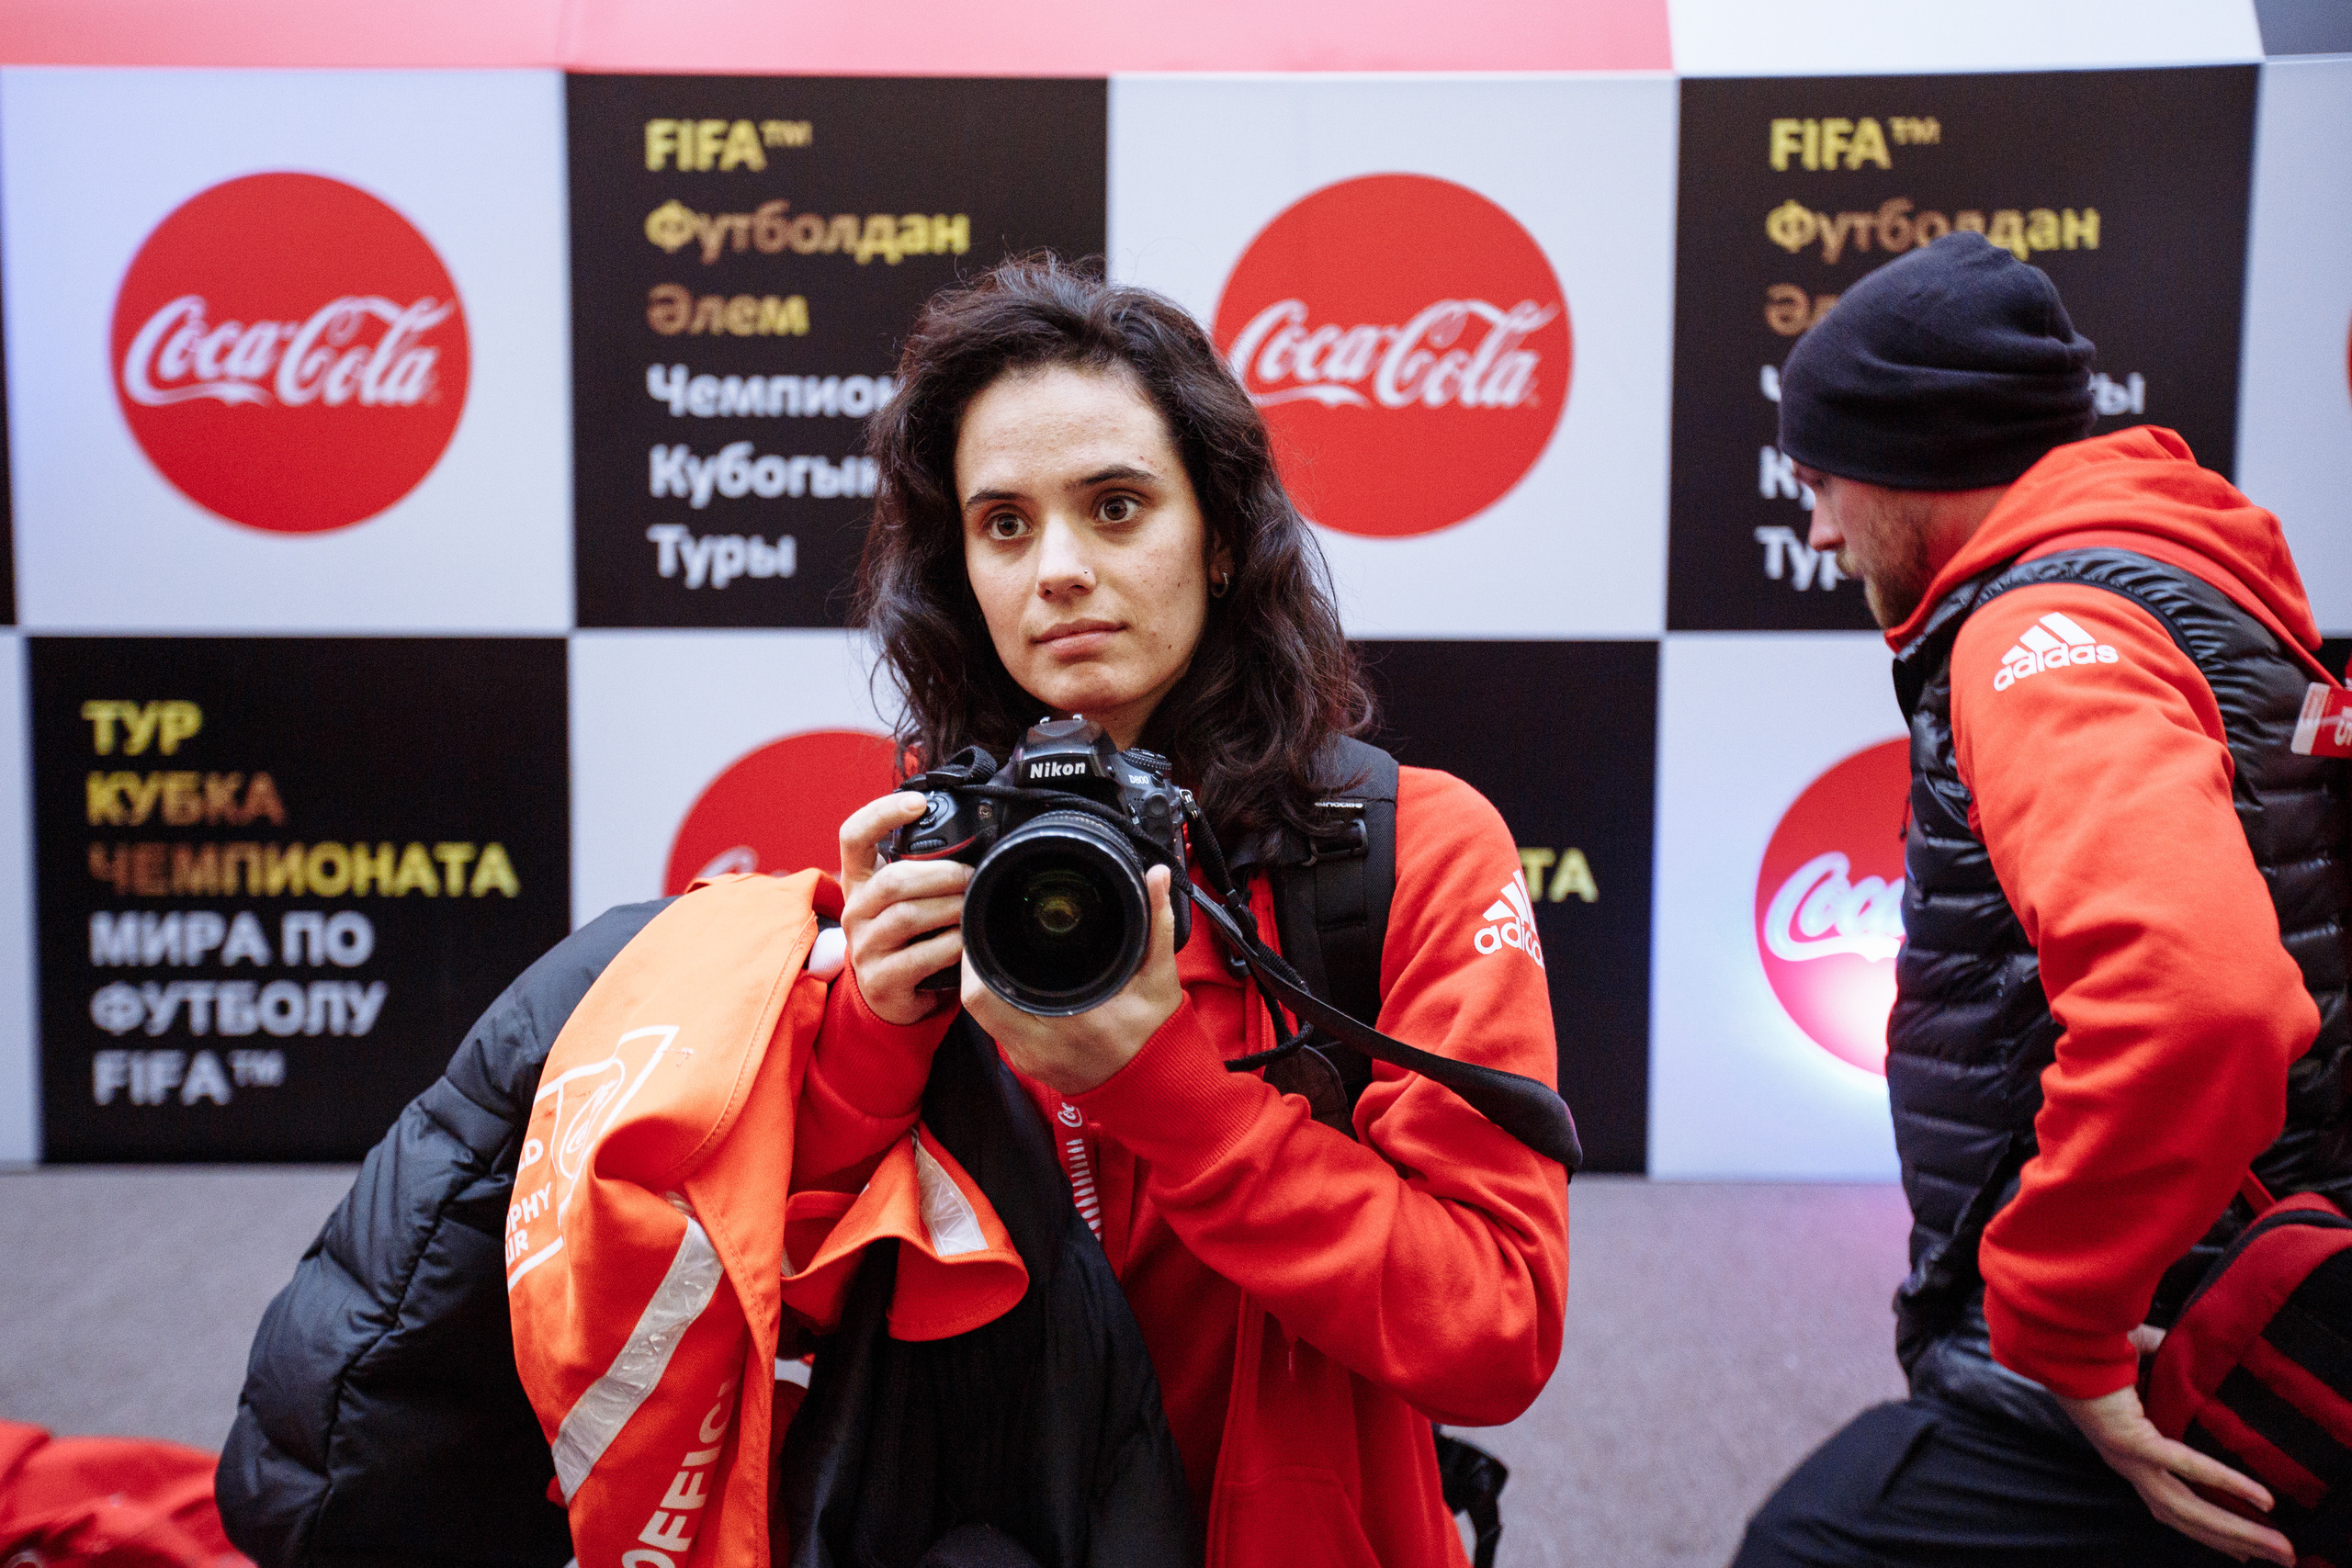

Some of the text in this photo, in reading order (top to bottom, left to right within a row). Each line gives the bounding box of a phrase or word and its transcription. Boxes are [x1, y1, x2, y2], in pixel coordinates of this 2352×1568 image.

[645, 199, 970, 265] Футболдан
[647, 284, 809, 336] Әлем
[122, 295, 457, 408] Coca-Cola
[1227, 298, 1561, 410] Coca-Cola
[646, 523, 797, 590] Туры
[1993, 643, 2120, 692] adidas
[82, 699, 202, 756] ТУР
[1029, 761, 1086, 779] Nikon
[85, 771, 285, 827] КУБКА
[88, 841, 521, 898] ЧЕМПИОНАТА
[1518, 846, 1600, 904] ТА
[90, 911, 377, 968] МИРА ПО
[1474, 916, 1544, 970] adida
[90, 979, 390, 1037] ФУТБОЛУ
[505, 1229, 529, 1269] UR
